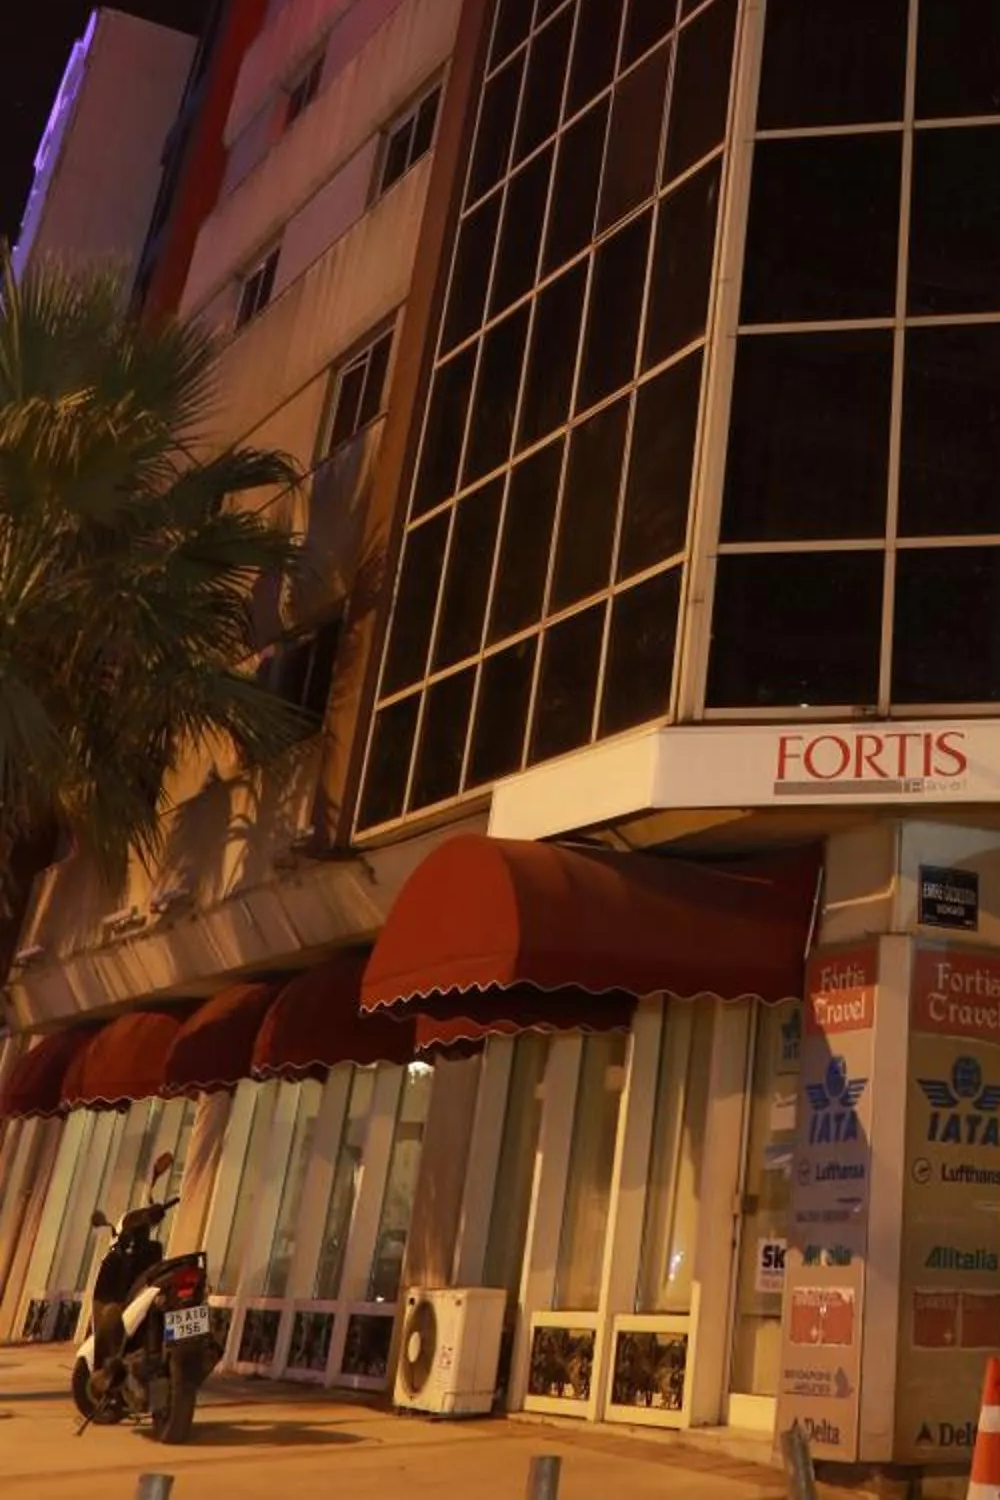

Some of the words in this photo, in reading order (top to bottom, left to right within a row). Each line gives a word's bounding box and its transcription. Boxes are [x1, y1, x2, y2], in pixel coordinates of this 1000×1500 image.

[776, 732, 967, 779] FORTIS
[820, 962, 866, 993] Fortis
[814, 992, 866, 1024] Travel
[809, 1109, 858, 1145] IATA
[927, 1110, 1000, 1146] IATA
[925, 1246, 999, 1272] Alitalia
